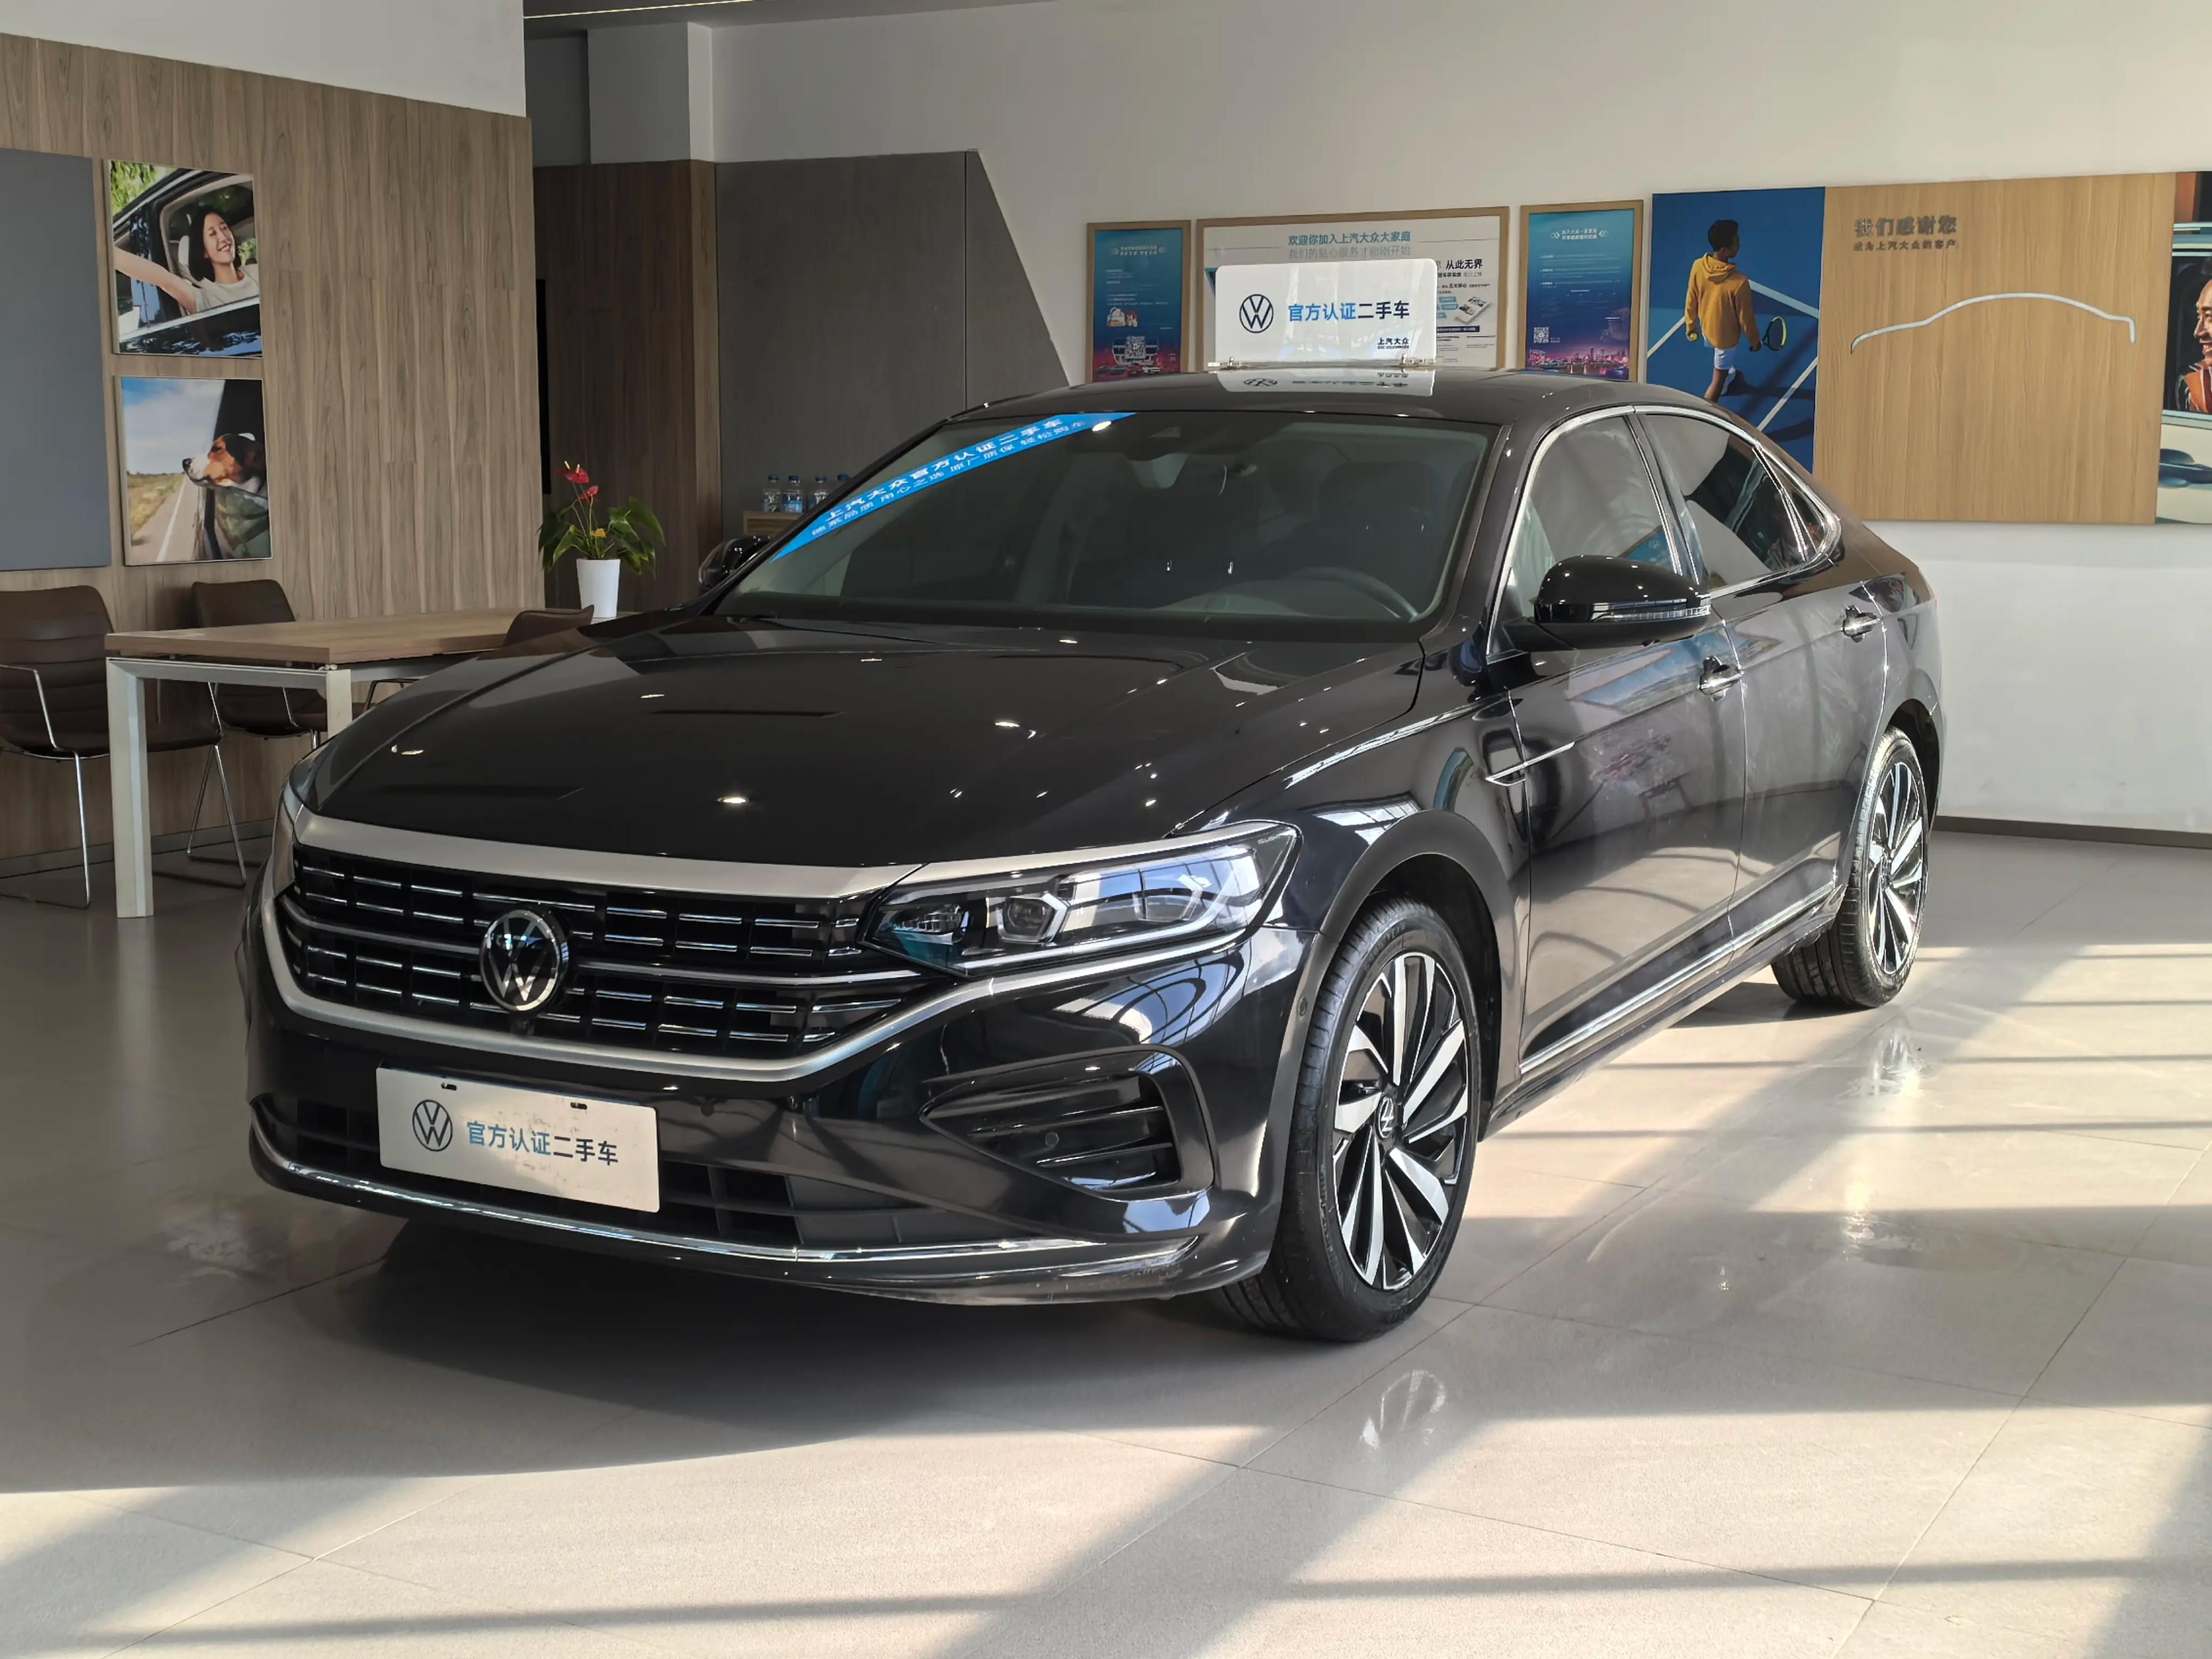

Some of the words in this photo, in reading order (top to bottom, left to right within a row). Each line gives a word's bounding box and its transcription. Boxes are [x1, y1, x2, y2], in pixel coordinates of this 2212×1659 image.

[1854, 215, 1957, 237] 我们感谢您
[1288, 232, 1411, 246] 欢迎你加入上汽大众大家庭
[1853, 239, 1956, 252] 成为上汽大众的客户
[1446, 259, 1483, 270] 从此无界
[1288, 300, 1410, 322] 官方认证二手车
[1377, 337, 1410, 345] 上汽大众
[825, 419, 1064, 522] 上汽大众官方认证二手车
[467, 1121, 619, 1165] 官方认证二手车
